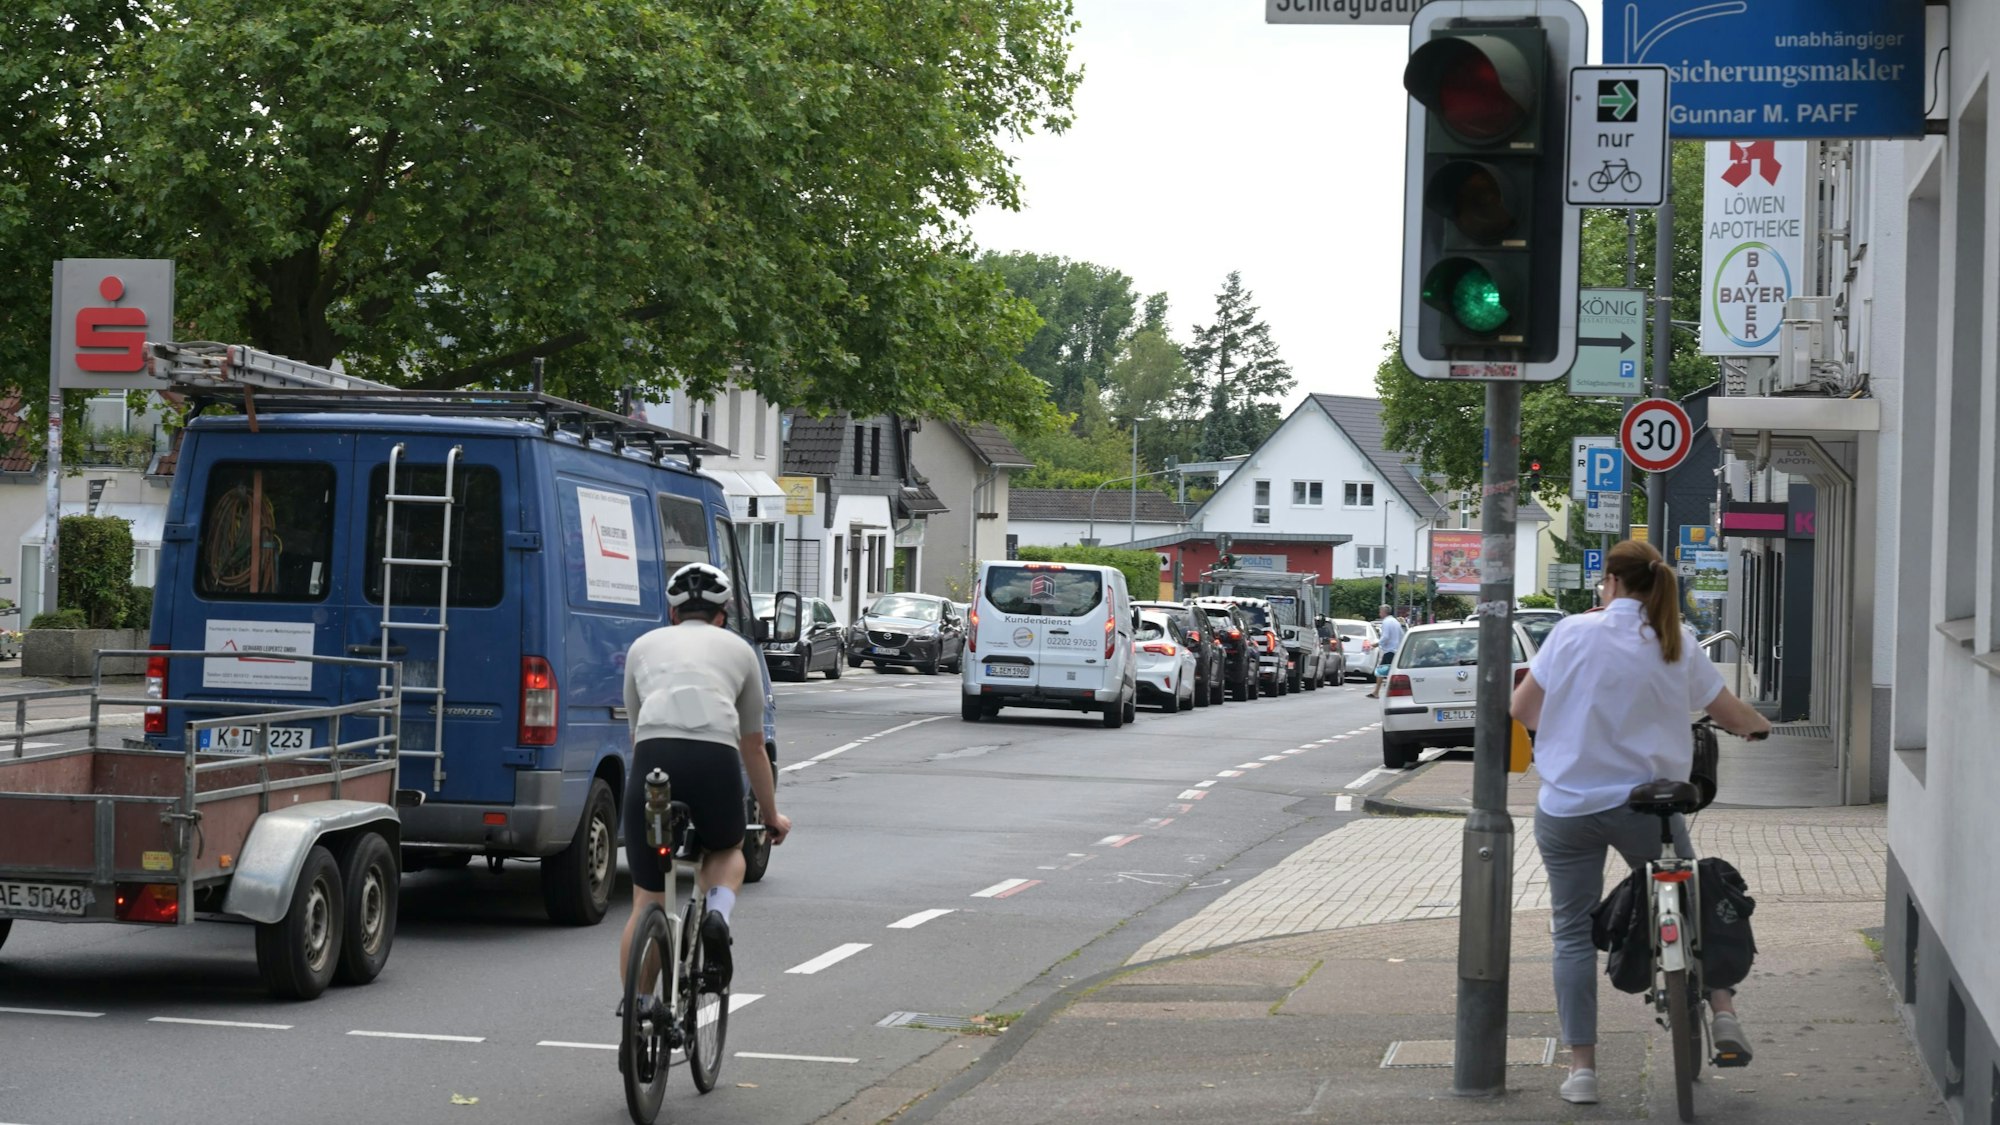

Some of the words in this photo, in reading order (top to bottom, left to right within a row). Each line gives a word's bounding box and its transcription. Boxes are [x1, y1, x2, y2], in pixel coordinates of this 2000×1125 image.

[1775, 31, 1905, 50] unabhängiger
[1668, 58, 1905, 88] sicherungsmakler
[1670, 104, 1756, 124] Gunnar
[1763, 103, 1789, 123] M.
[1797, 103, 1858, 123] PAFF
[1597, 131, 1634, 148] nur
[1724, 192, 1785, 215] LÖWEN
[1709, 219, 1800, 240] APOTHEKE
[1720, 287, 1785, 304] BAYER
[1580, 296, 1637, 316] KÖNIG
[1636, 419, 1676, 451] 30
[1595, 453, 1615, 486] P
[1588, 552, 1600, 568] P
[1004, 615, 1072, 626] Kundendienst
[1047, 637, 1071, 646] 02202
[1073, 638, 1098, 647] 97630
[1443, 711, 1453, 720] GL
[1458, 710, 1469, 719] LL
[217, 727, 230, 748] K
[242, 729, 253, 747] D
[270, 730, 304, 748] 223
[28, 886, 83, 911] 5048
